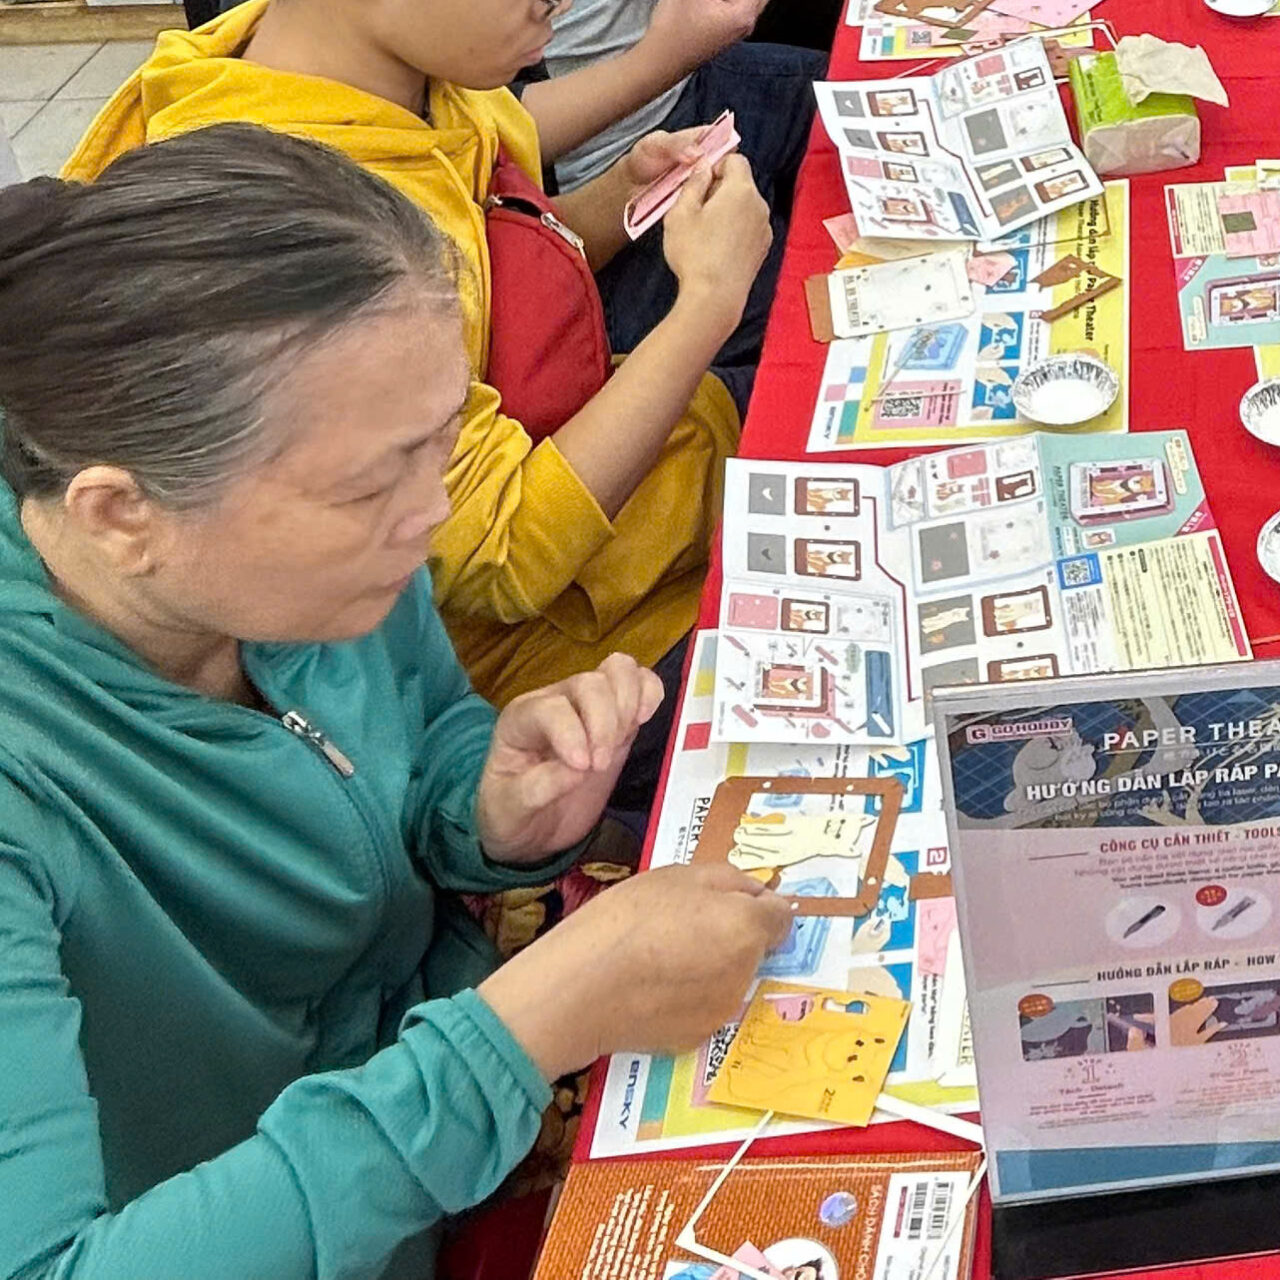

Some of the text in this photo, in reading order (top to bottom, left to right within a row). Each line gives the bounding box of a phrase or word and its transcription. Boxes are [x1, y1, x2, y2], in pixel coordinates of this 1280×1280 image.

[1085, 305, 1096, 341] Theater
[970, 727, 987, 742] G
[1103, 726, 1197, 752] PAPER
[1026, 775, 1112, 801] HƯỚNG
[1117, 767, 1163, 792] DẪN
[1167, 764, 1209, 788] LẮP
[1215, 761, 1259, 783] RÁP
[1100, 838, 1138, 854] CÔNG
[1141, 837, 1161, 853] CỤ
[1194, 829, 1231, 846] THIẾT
[929, 849, 946, 864] 2
[1145, 961, 1172, 978] DẪN
[1176, 959, 1200, 974] LẮP
[1203, 957, 1231, 971] RÁP
[1246, 954, 1276, 967] HOW
